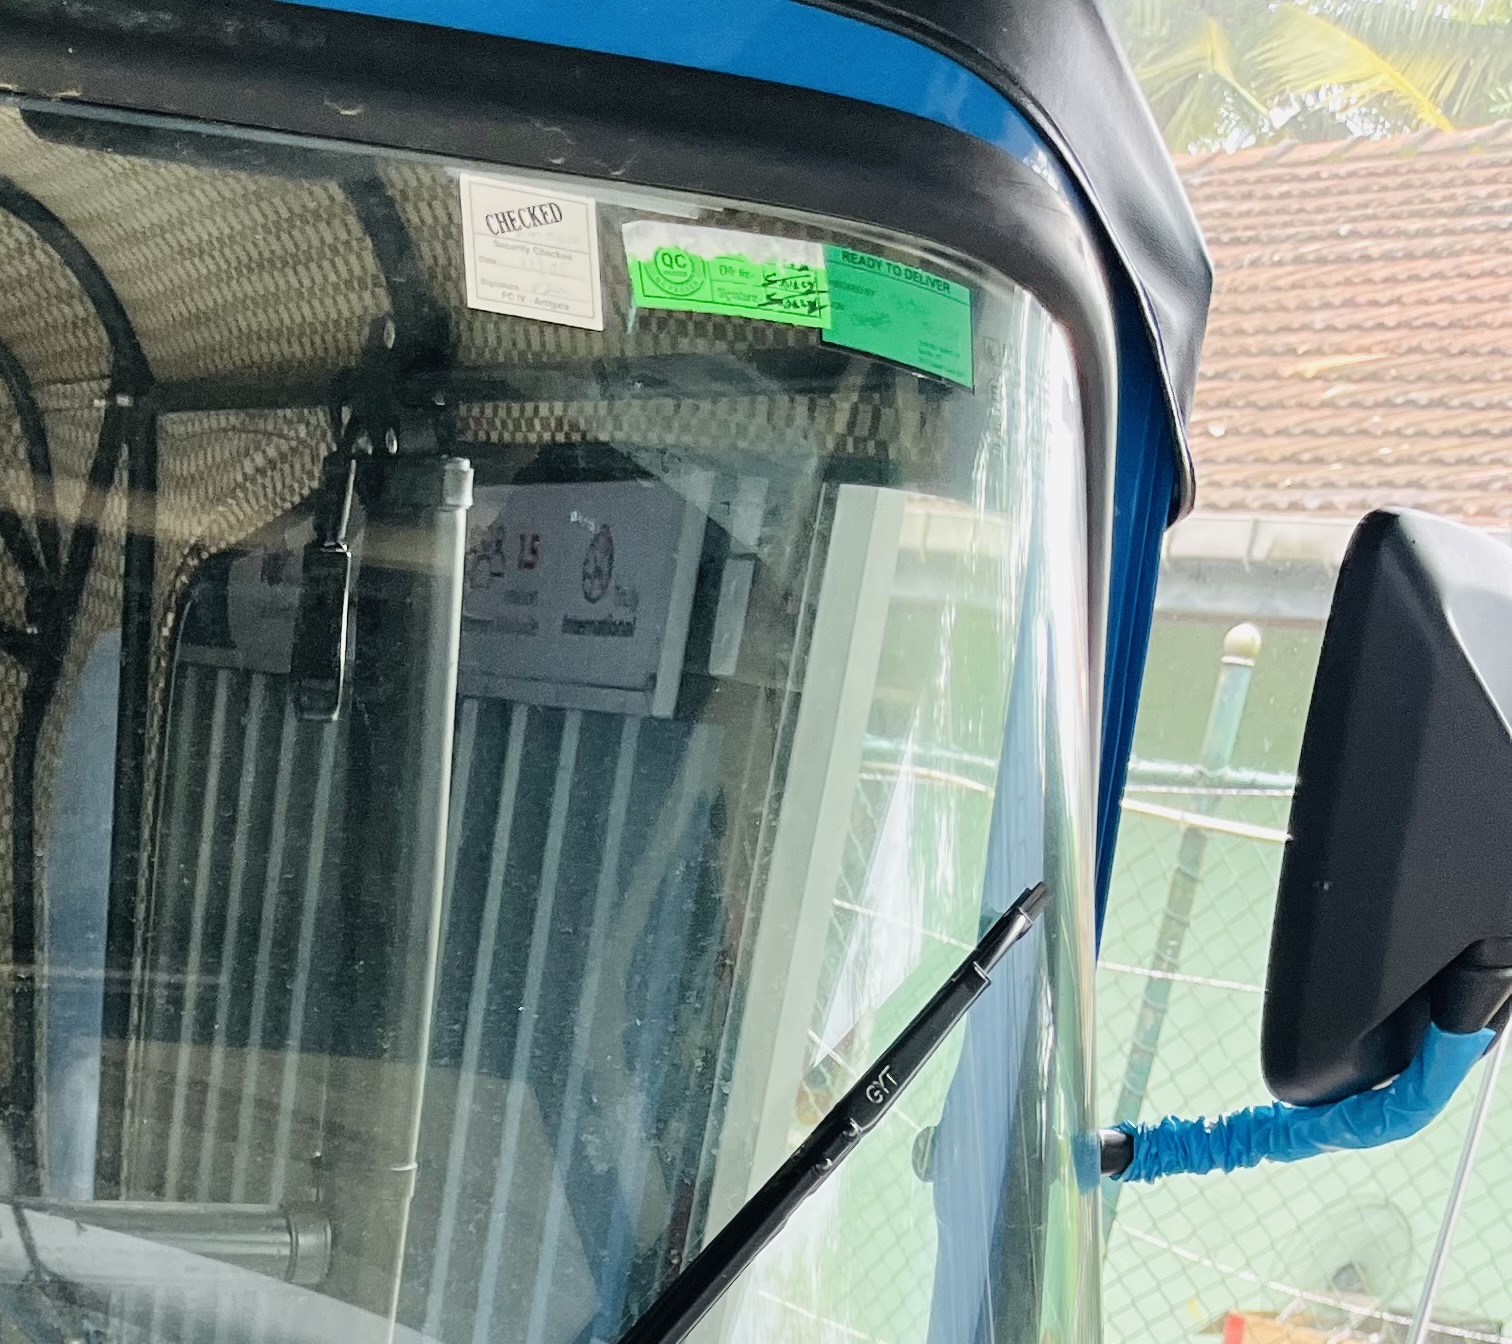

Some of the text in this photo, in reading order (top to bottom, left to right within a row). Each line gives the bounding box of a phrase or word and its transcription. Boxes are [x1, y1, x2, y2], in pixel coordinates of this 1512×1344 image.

[486, 202, 563, 236] CHECKED
[661, 252, 687, 270] QC
[841, 250, 951, 294] READY TO DELIVER
[865, 1064, 898, 1104] GYT
